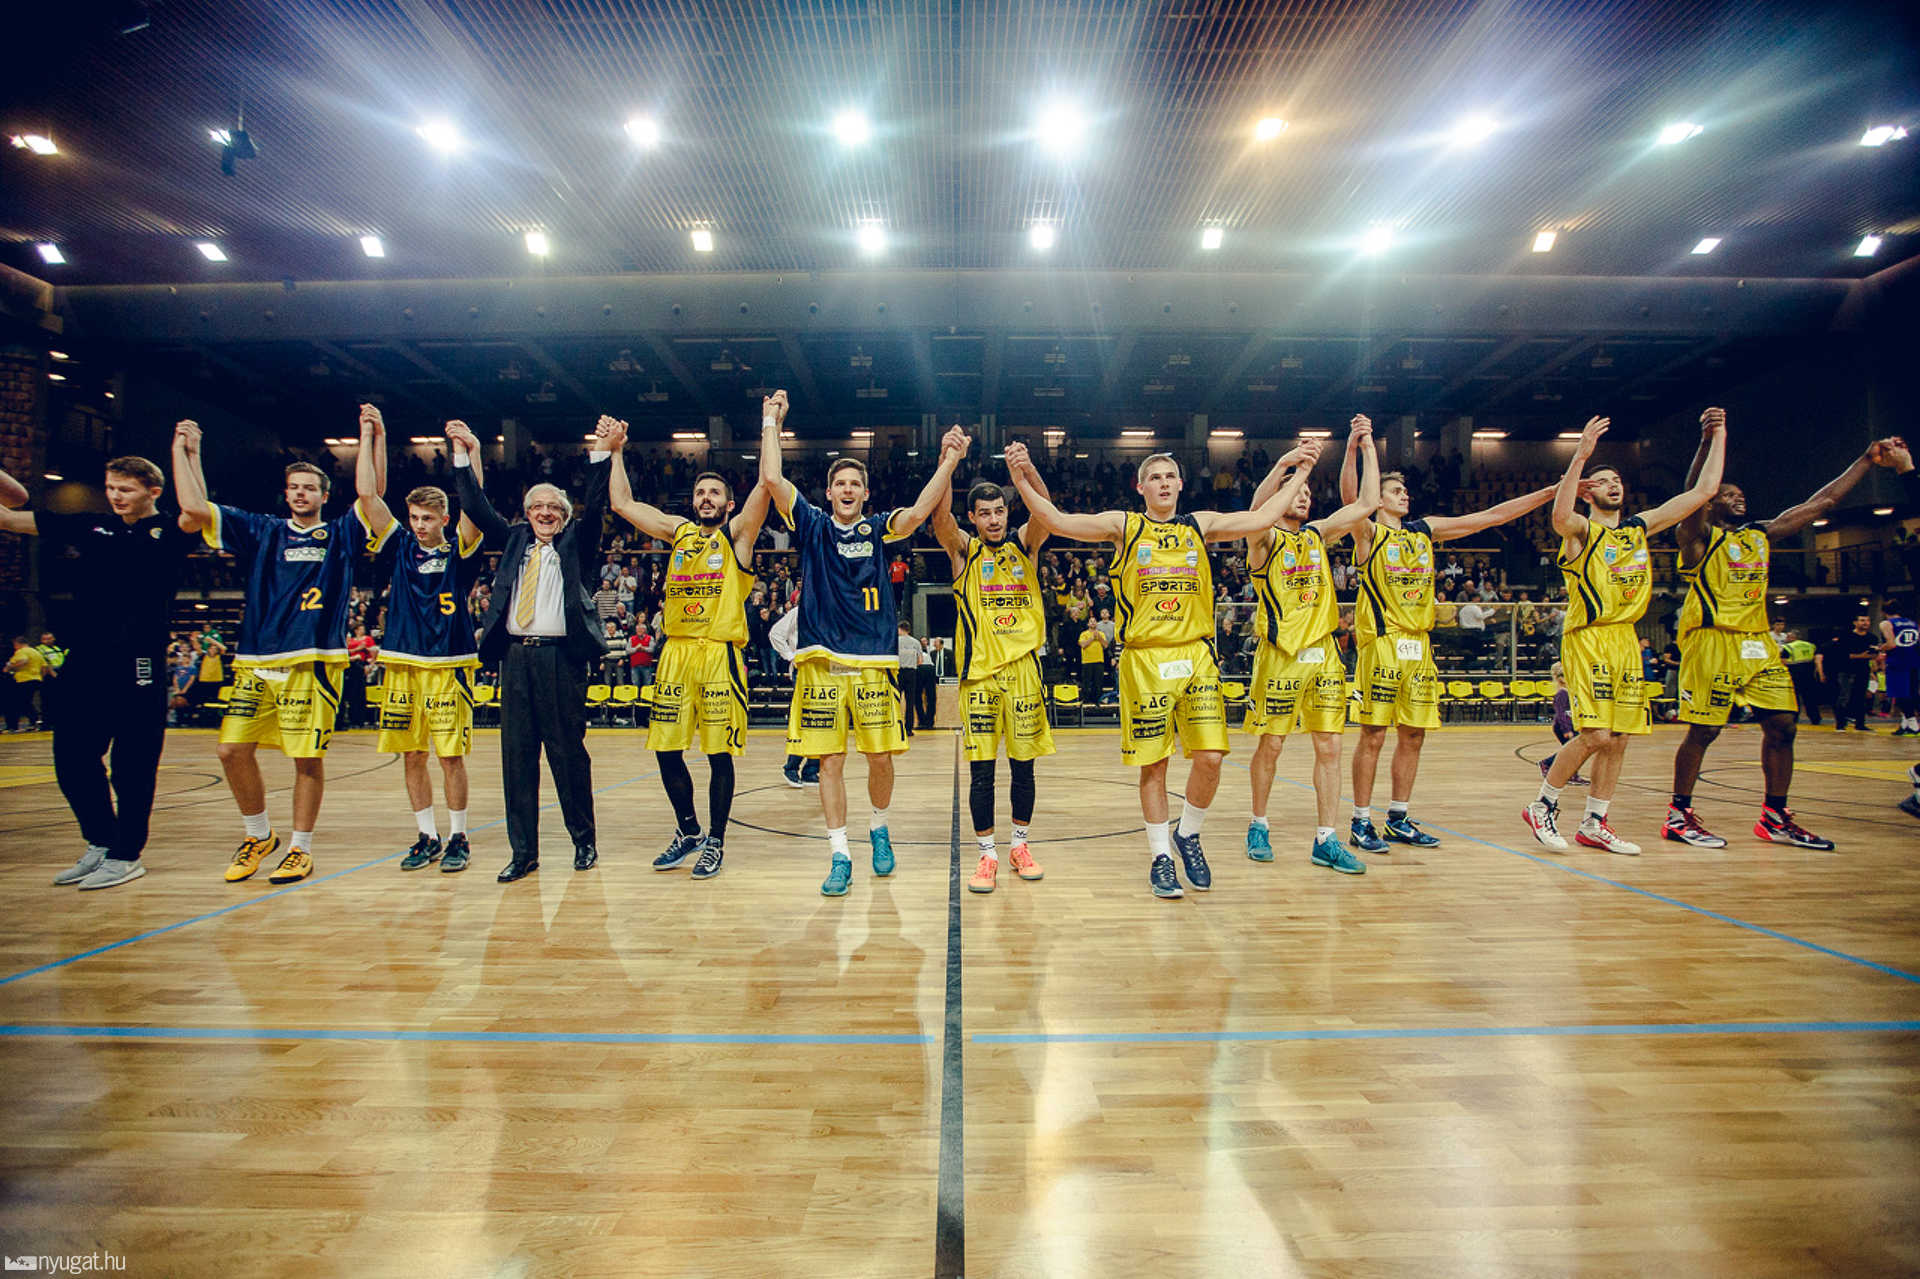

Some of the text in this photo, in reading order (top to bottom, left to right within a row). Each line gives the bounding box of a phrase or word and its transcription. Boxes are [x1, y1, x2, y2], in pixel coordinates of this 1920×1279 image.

[670, 585, 722, 596] SPORT36
[1141, 581, 1198, 592] SPORT36
[439, 592, 456, 615] 5
[862, 587, 880, 611] 11
[1268, 679, 1301, 691] FLAG
[803, 687, 837, 700] FLAG
